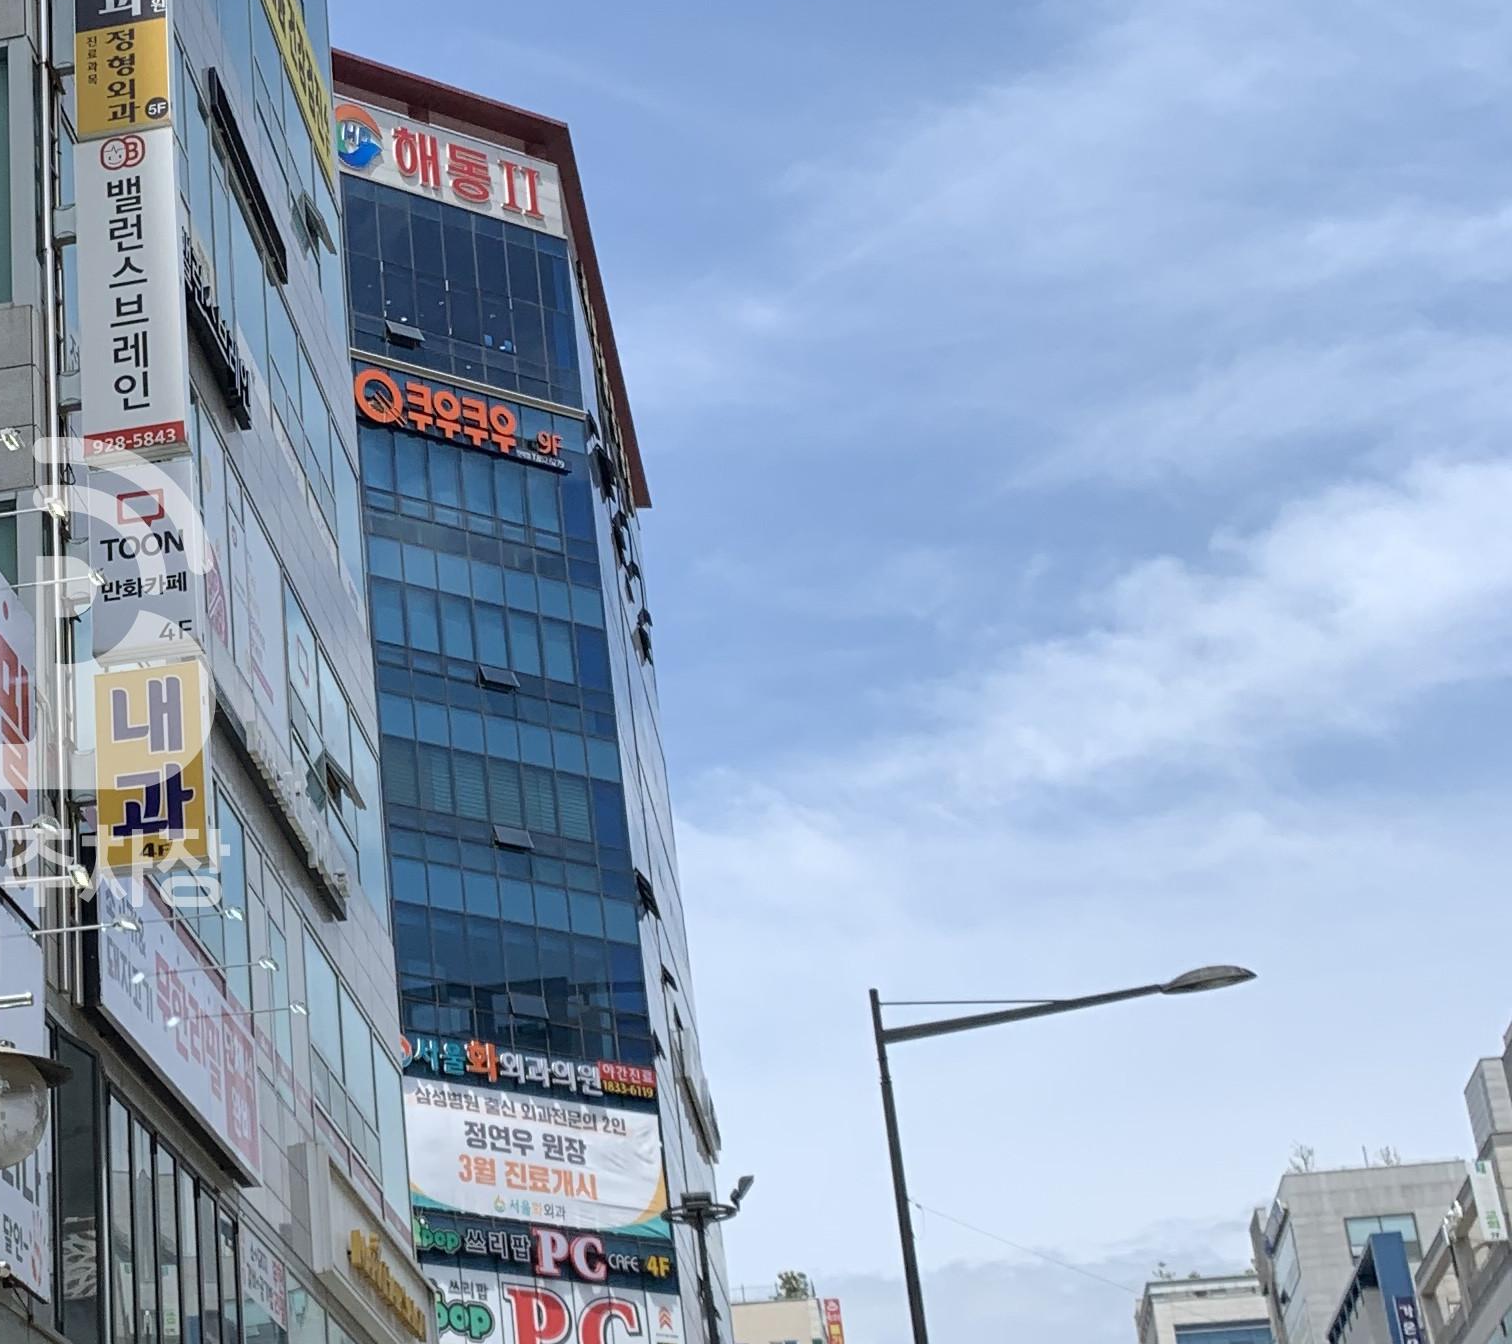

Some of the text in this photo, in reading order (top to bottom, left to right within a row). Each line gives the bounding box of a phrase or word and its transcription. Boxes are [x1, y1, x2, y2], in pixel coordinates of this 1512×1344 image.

[106, 28, 140, 124] 정형외과
[147, 102, 167, 116] 5F
[106, 175, 150, 411] 밸런스브레인
[91, 430, 177, 455] 928-5843
[536, 431, 564, 456] 9F
[100, 529, 185, 562] TOON
[159, 619, 193, 641] 4F
[109, 674, 195, 841] 내과
[141, 841, 171, 859] 4F
[601, 1114, 627, 1136] 2인
[464, 1120, 586, 1166] 정연우 원장
[458, 1153, 598, 1201] 3월 진료개시
[531, 1225, 608, 1282] PC
[608, 1253, 640, 1273] CAFE
[646, 1255, 671, 1278] 4F
